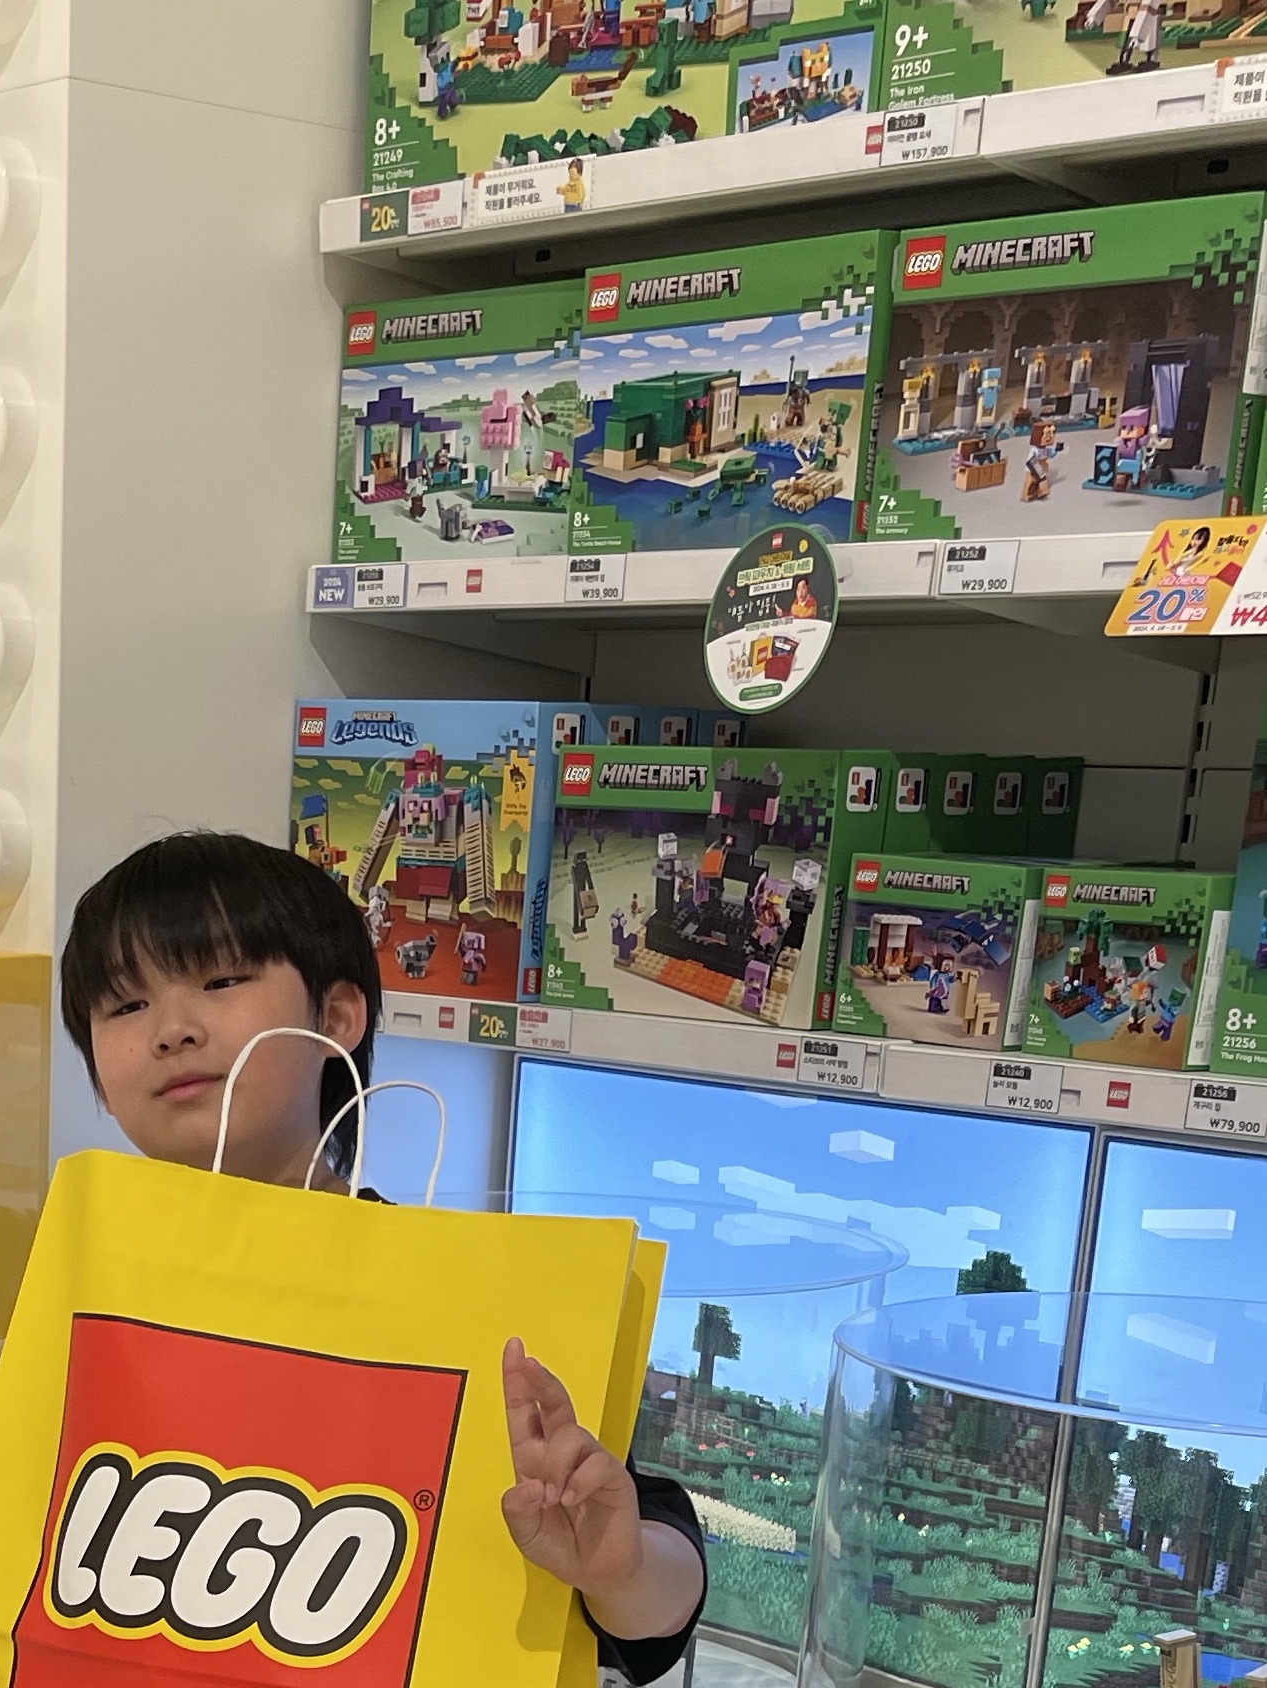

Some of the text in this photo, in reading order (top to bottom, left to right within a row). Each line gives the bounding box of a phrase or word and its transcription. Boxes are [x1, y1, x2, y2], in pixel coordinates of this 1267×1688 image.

[895, 24, 929, 57] 9+
[891, 59, 931, 80] 21250
[374, 118, 401, 146] 8+
[372, 148, 404, 167] 21249
[906, 230, 1095, 276] LEGO MINECRAFT
[590, 267, 742, 310] LEGO MINECRAFT
[349, 308, 484, 344] LEGO MINECRAFT
[878, 495, 897, 512] 7+
[339, 522, 353, 536] 7+
[574, 511, 590, 527] 8+
[319, 588, 345, 602] NEW
[300, 718, 325, 736] LEGO
[564, 762, 709, 792] LEGO MINECRAFT
[856, 870, 971, 894] LEGO MINECRAFT
[1047, 883, 1157, 906] LEGO MINECRAFT
[547, 964, 563, 979] 8+
[1226, 1008, 1257, 1031] 8+
[1222, 1035, 1257, 1049] 21256
[1209, 1117, 1260, 1134] ₩79,900
[50, 1453, 408, 1658] LEGO
